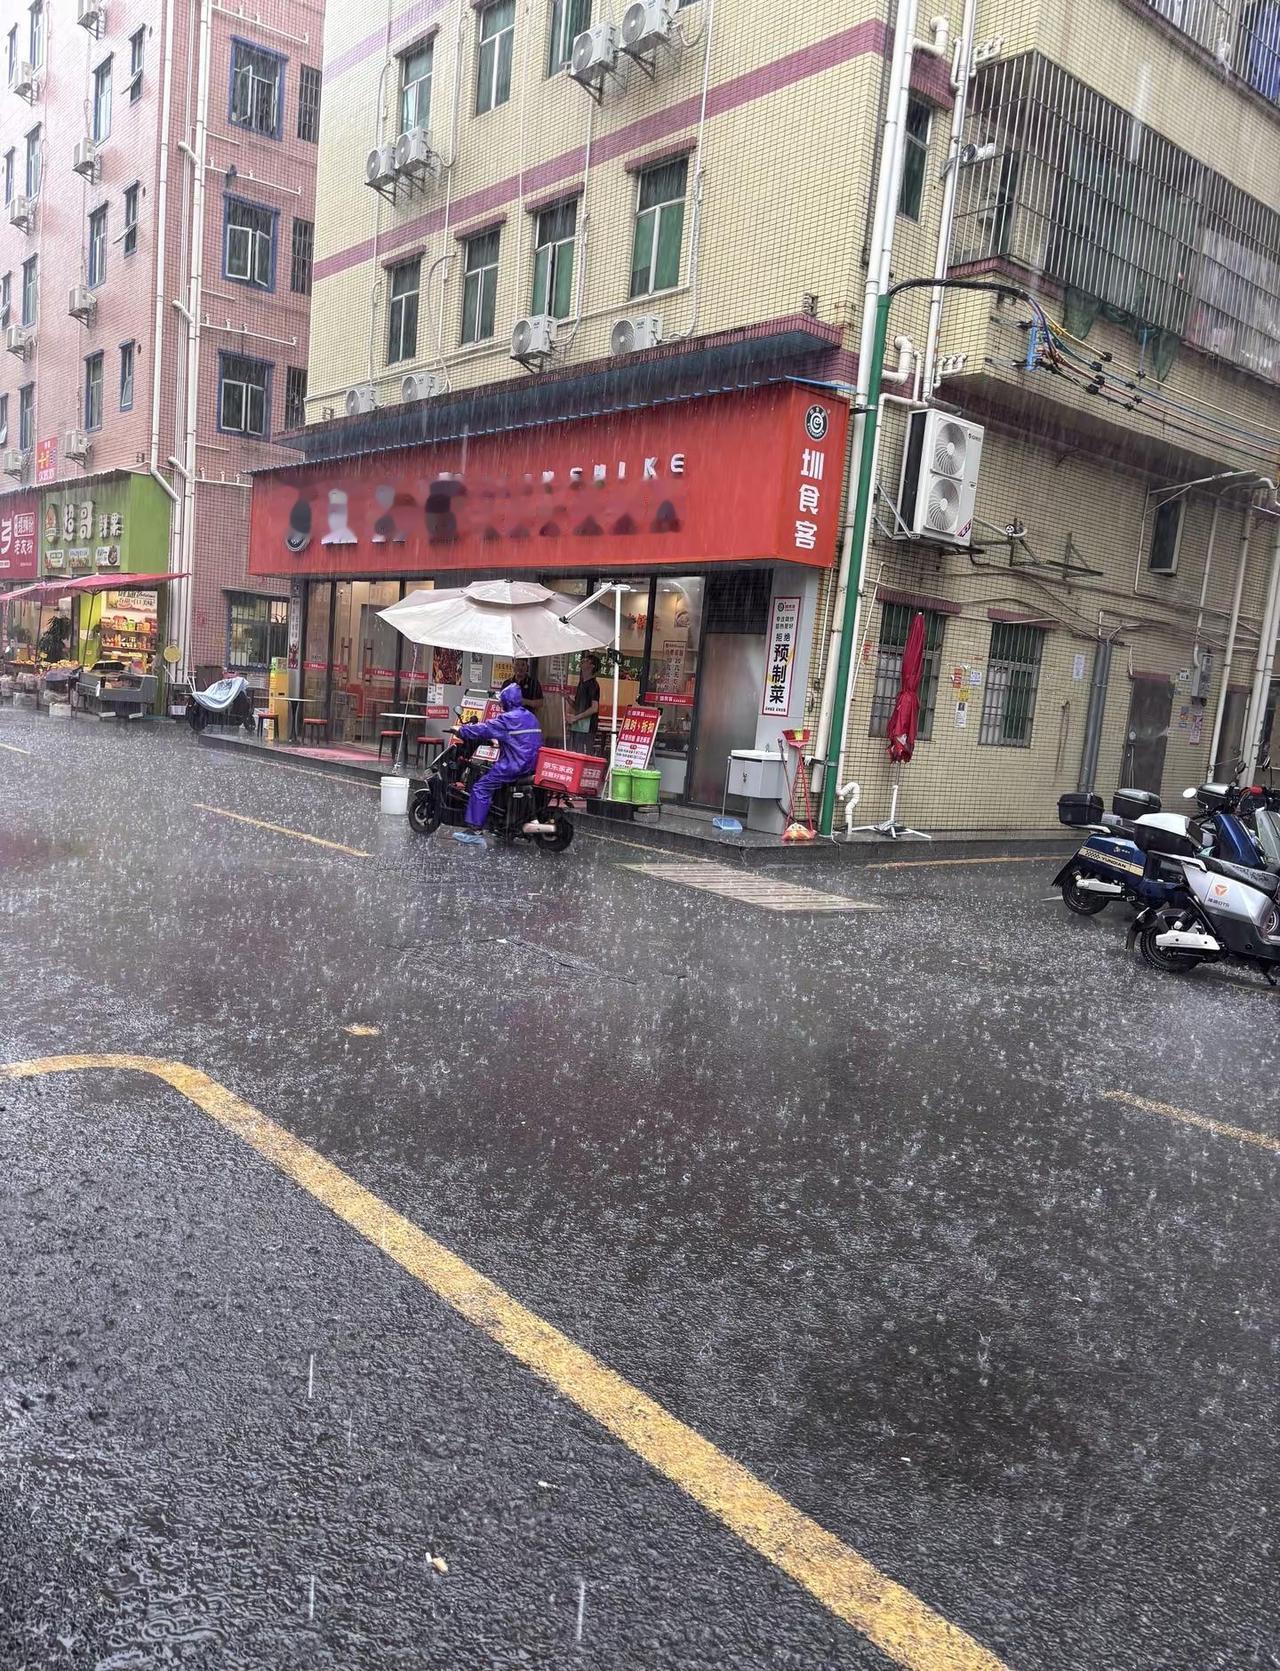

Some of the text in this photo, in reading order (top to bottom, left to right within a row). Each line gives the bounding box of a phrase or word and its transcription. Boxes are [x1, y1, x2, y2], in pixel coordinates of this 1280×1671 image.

[794, 448, 824, 550] 圳食客
[769, 643, 790, 704] 预制菜
